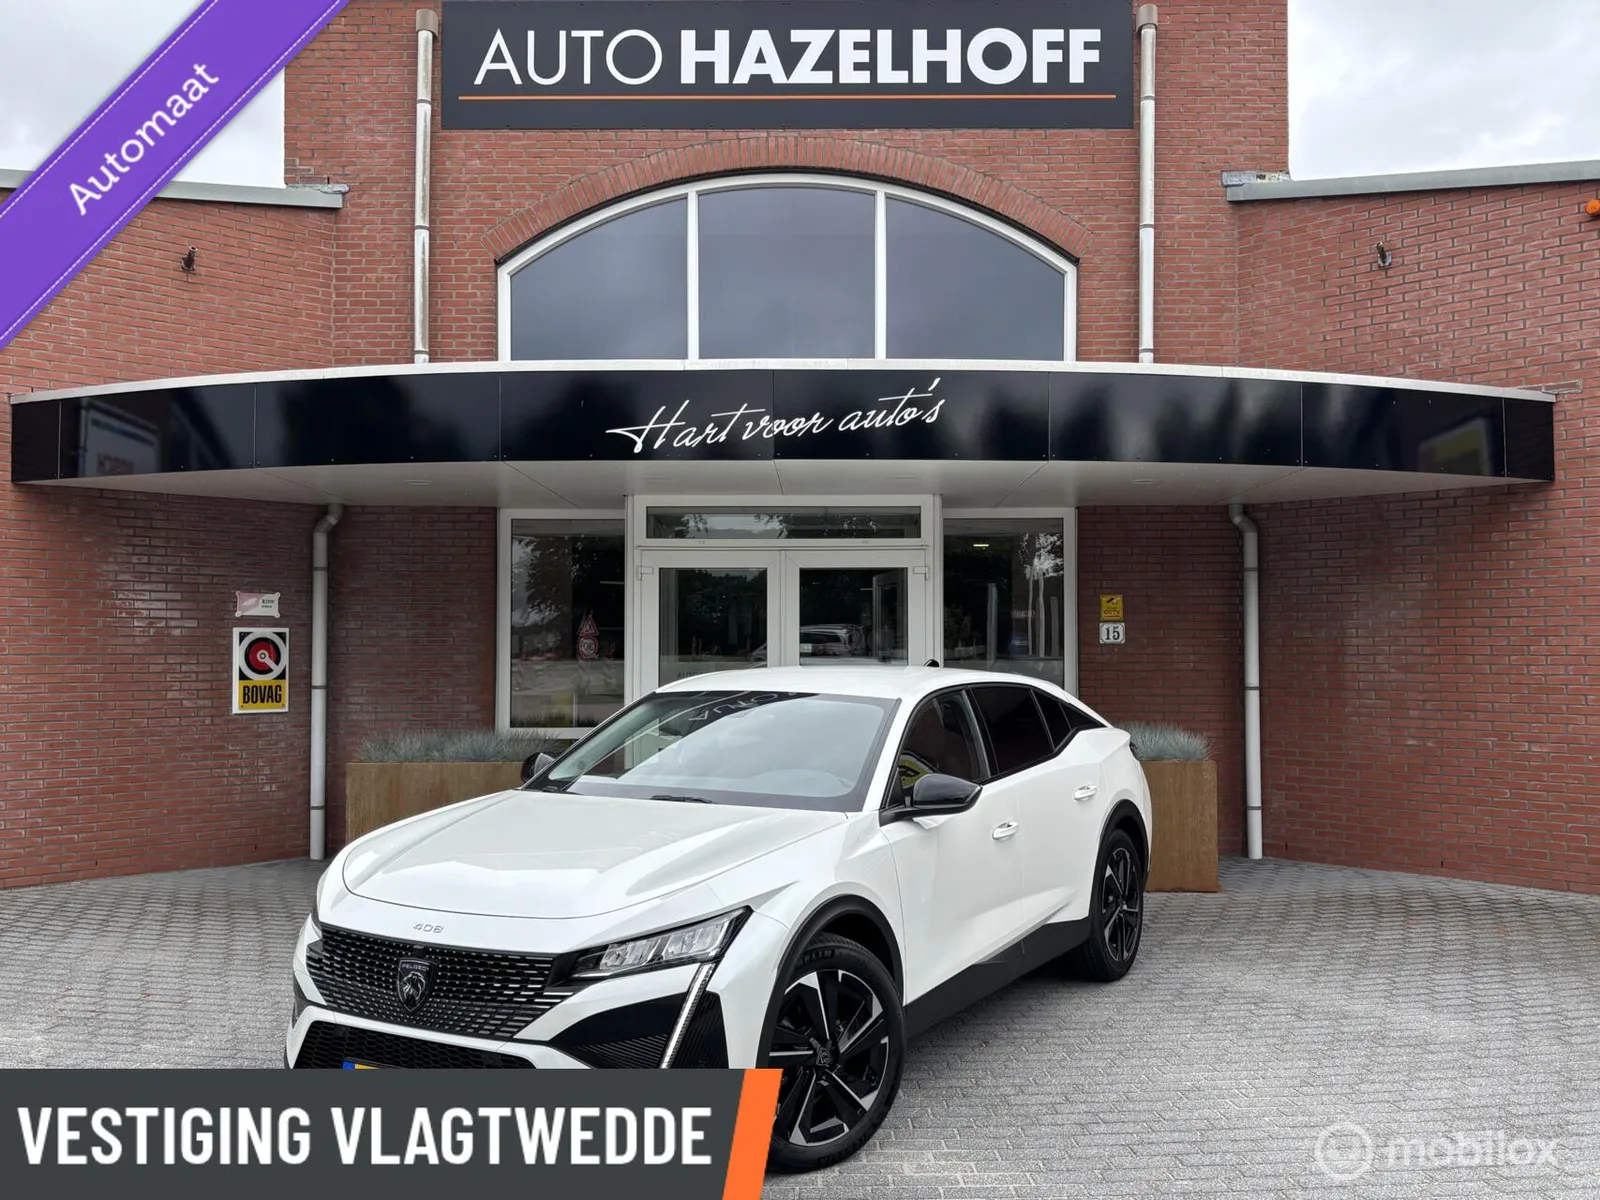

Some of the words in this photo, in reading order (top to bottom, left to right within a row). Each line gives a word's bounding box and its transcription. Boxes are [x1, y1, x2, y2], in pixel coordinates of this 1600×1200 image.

[474, 28, 663, 86] AUTO
[680, 27, 1101, 85] HAZELHOFF
[605, 400, 766, 454] Hart
[742, 412, 834, 442] voor
[838, 377, 946, 431] auto's
[1105, 626, 1120, 640] 15
[243, 685, 282, 704] BOVAG
[413, 923, 444, 934] 408
